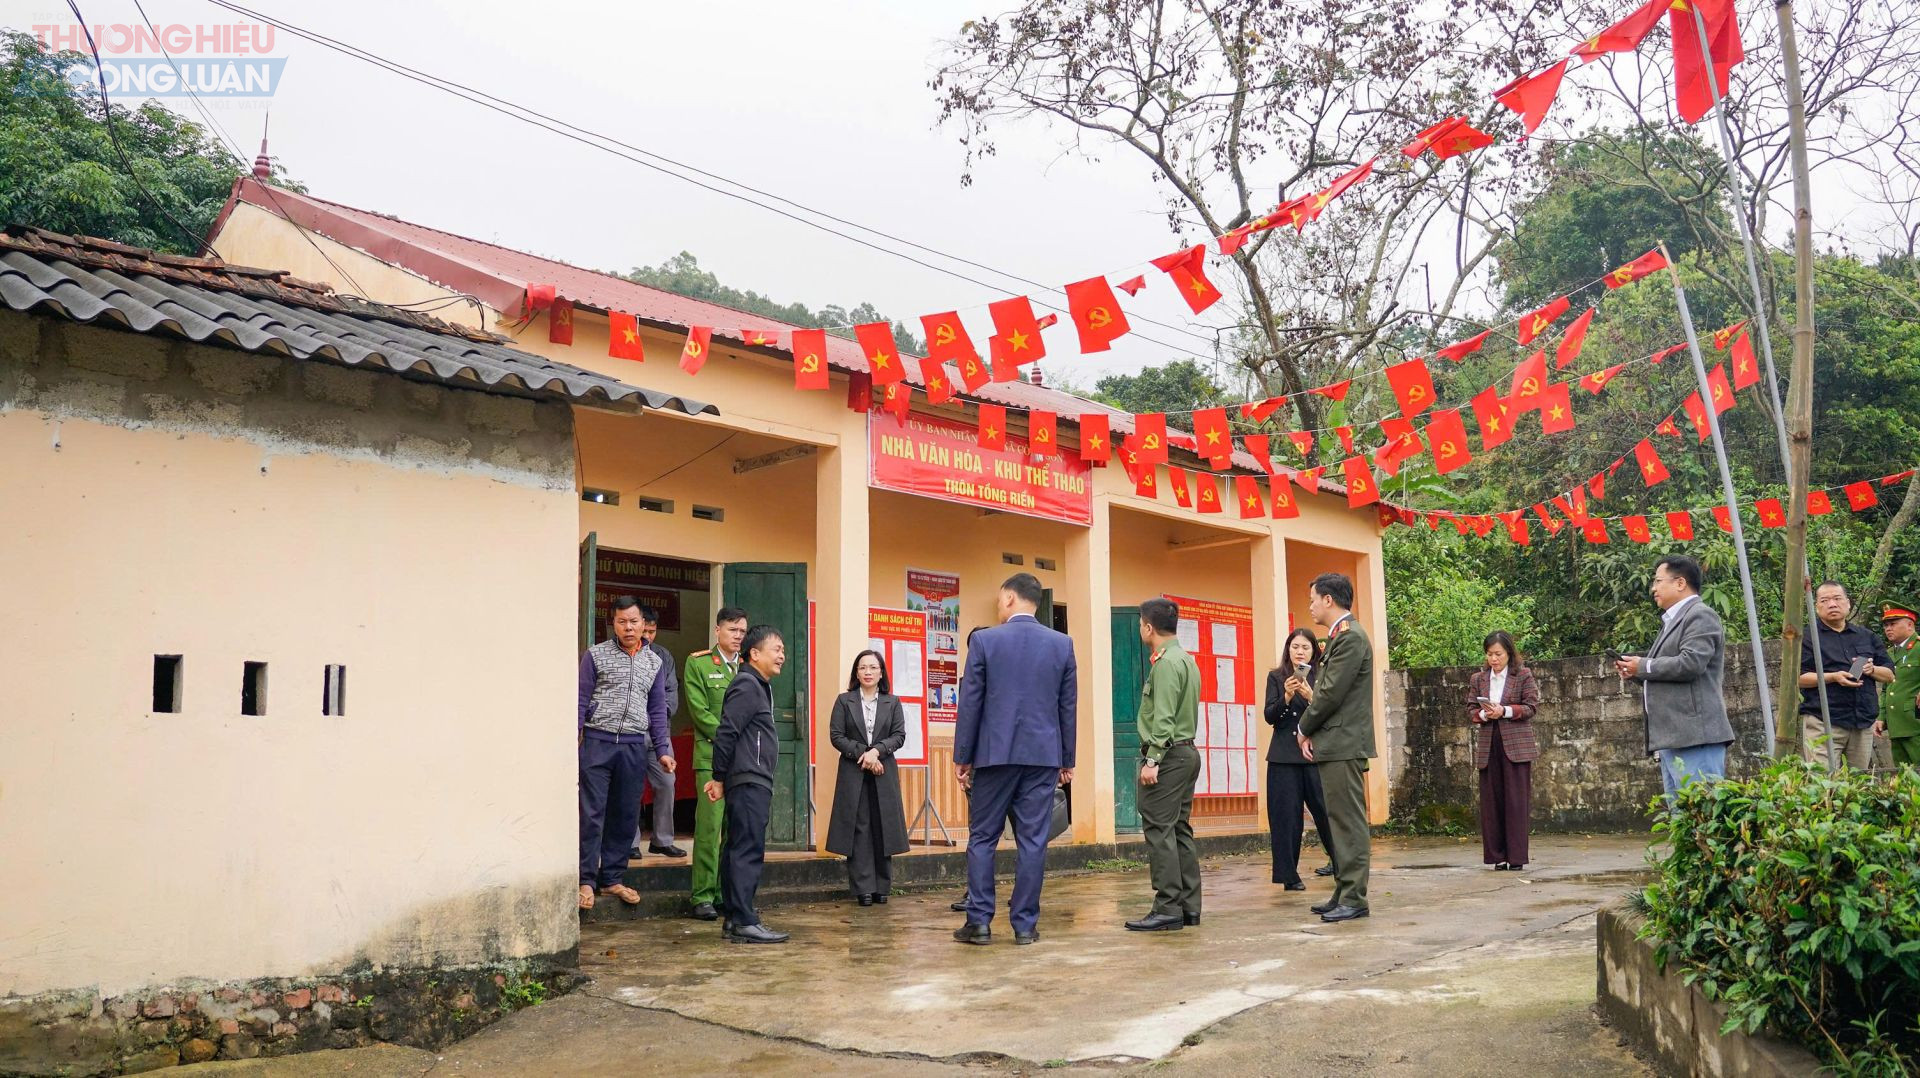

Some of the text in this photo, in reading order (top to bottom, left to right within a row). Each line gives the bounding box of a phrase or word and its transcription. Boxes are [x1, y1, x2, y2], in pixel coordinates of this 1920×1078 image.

[927, 423, 948, 437] BAN
[881, 434, 915, 460] NHÀ
[919, 441, 950, 468] VĂN
[953, 448, 983, 474] HÓA
[994, 459, 1022, 482] KHU
[1025, 463, 1050, 488] THỂ
[1053, 471, 1085, 495] THAO
[944, 478, 975, 497] THÔN
[650, 565, 681, 580] DANH
